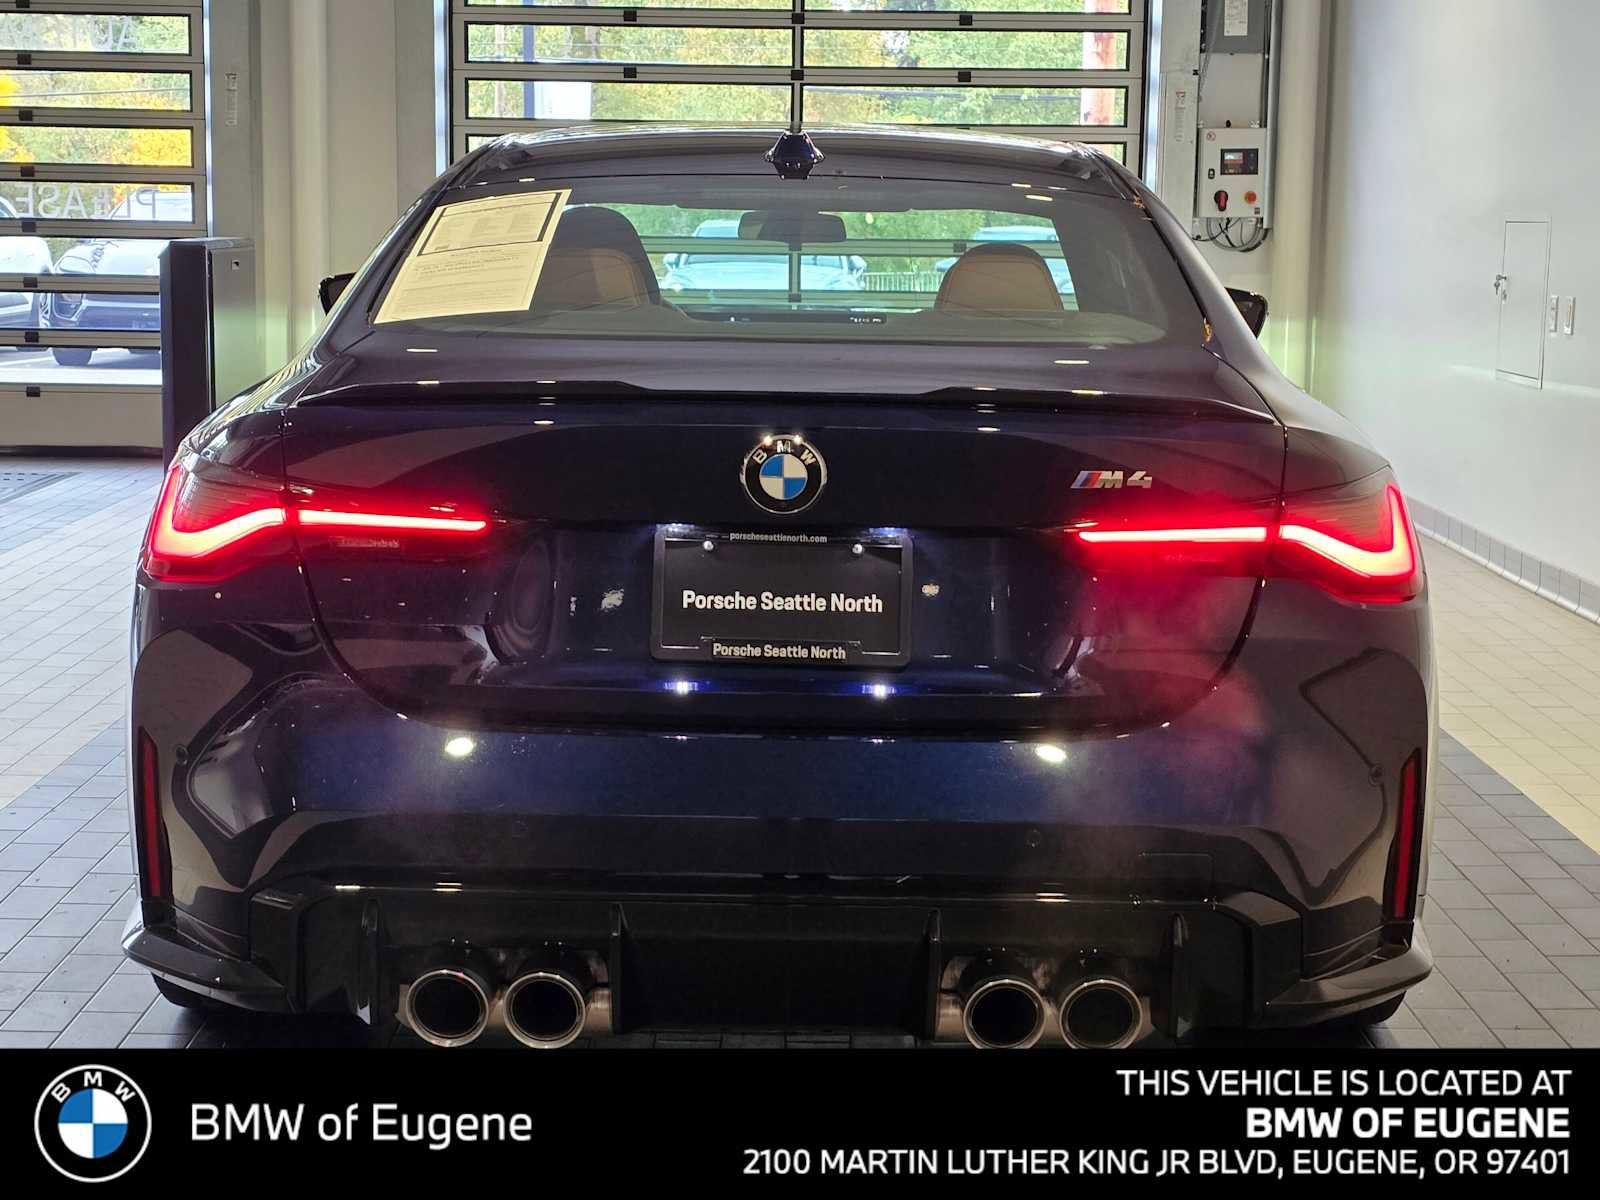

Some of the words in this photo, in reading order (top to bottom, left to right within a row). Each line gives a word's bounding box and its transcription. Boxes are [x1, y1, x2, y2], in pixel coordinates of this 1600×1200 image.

[752, 440, 817, 466] BMW
[1096, 470, 1152, 489] M4
[729, 532, 828, 543] porscheseattlenorth.com
[682, 589, 758, 610] Porsche
[760, 591, 827, 612] Seattle
[830, 592, 883, 613] North
[712, 642, 762, 659] Porsche
[763, 644, 809, 659] Seattle
[810, 645, 847, 660] North
